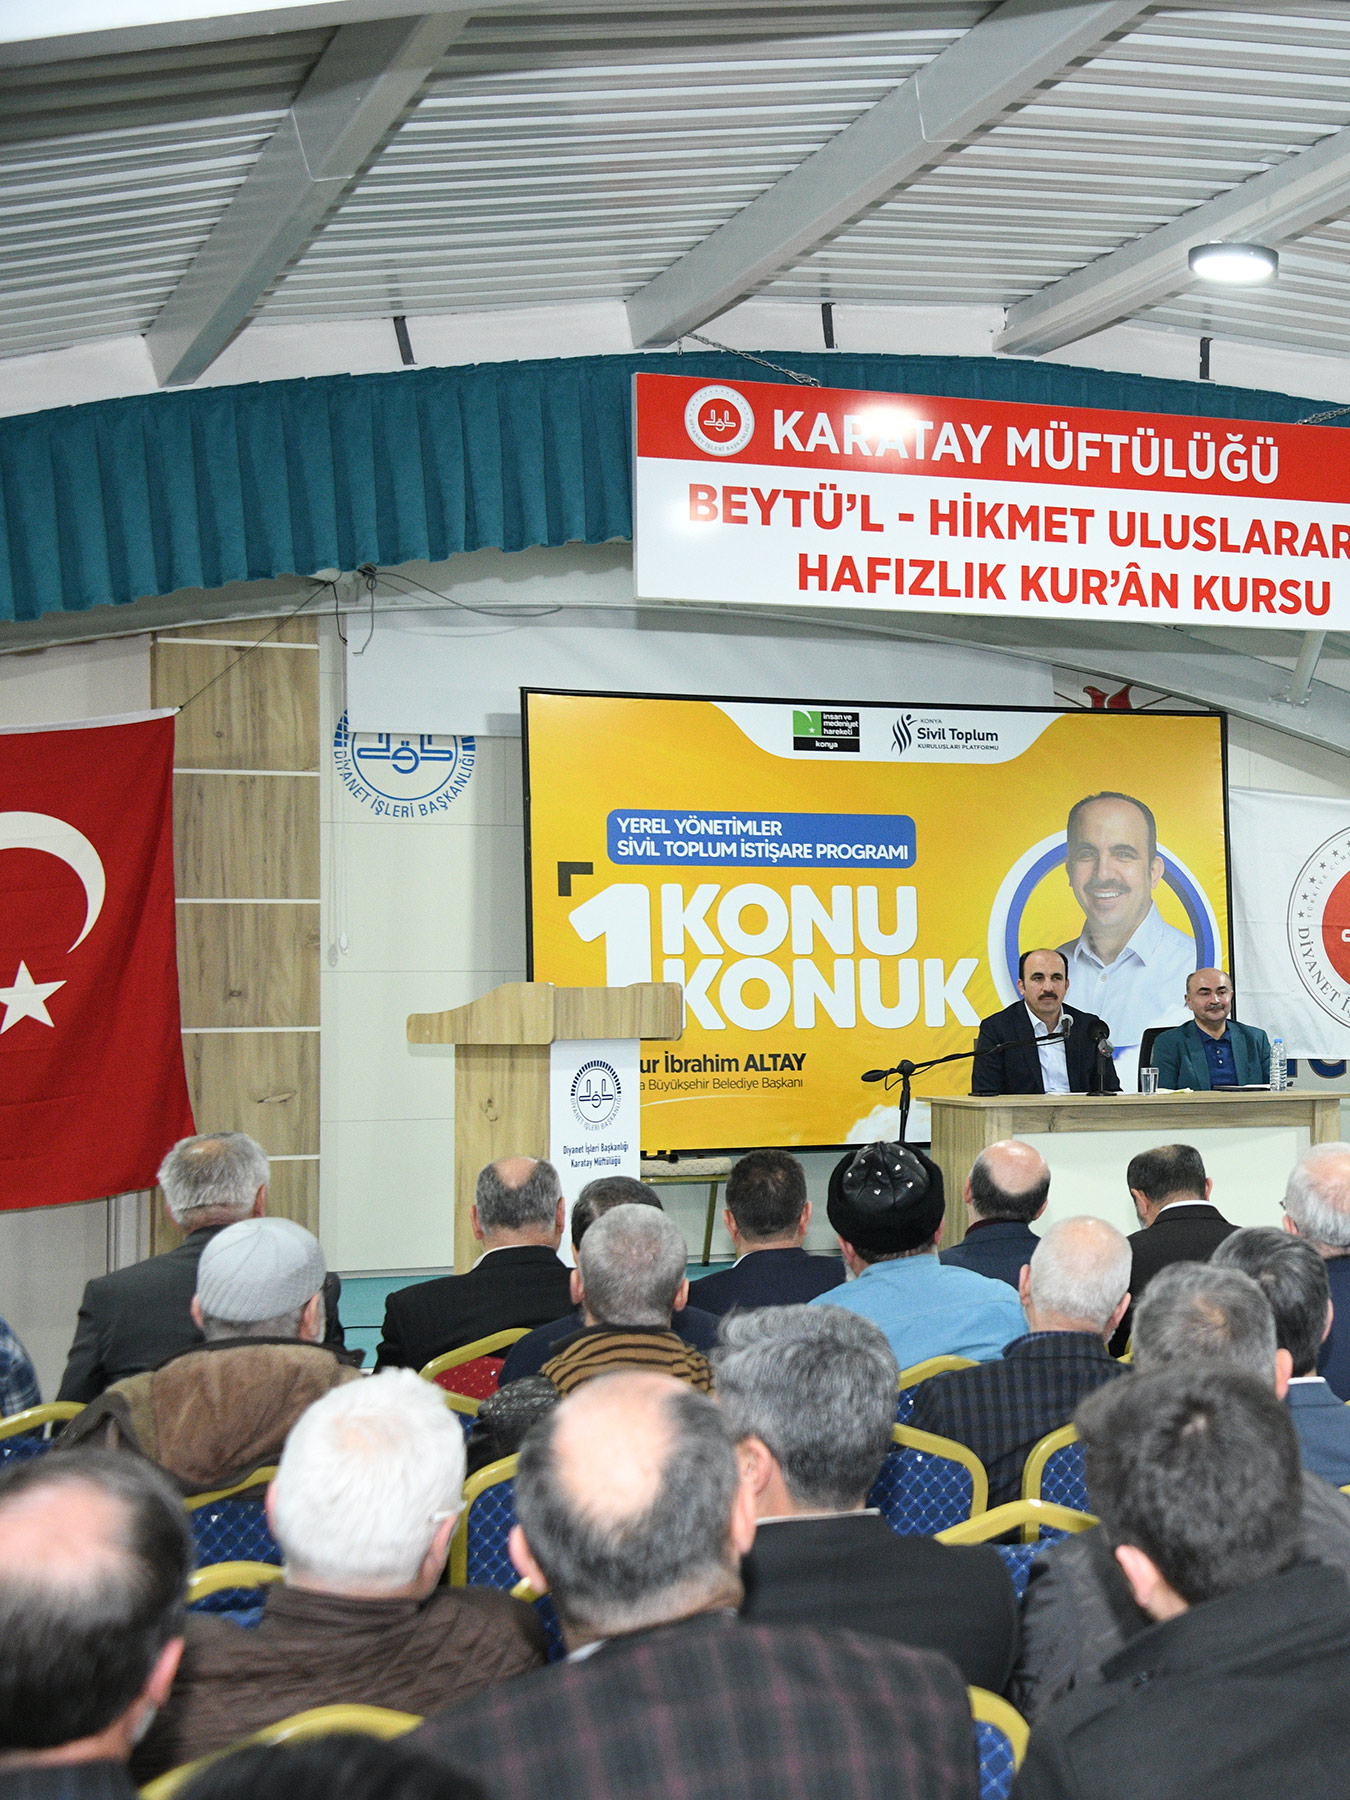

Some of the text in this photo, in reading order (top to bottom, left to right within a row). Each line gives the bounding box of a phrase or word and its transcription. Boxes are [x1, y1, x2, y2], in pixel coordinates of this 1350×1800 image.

[773, 408, 1279, 484] KARATAY MÜFTÜLÜĞÜ
[929, 492, 1095, 544] HİKMET
[798, 552, 1007, 600] HAFIZLIK
[1193, 574, 1331, 616] KURSU
[823, 720, 859, 729] medeniyet
[823, 727, 853, 736] hareketi
[917, 727, 999, 744] Sivil Toplum
[815, 740, 839, 750] konya
[370, 795, 415, 818] İŞLERİ
[418, 753, 476, 817] BAŞKANLIĞI
[616, 815, 783, 836] YEREL YÖNETİMLER
[617, 838, 909, 863] SİVİL TOPLUM İSTİŞARE PROGRAMI
[568, 883, 918, 987] 1 KONU
[1298, 926, 1341, 1004] DİYANET
[662, 958, 980, 1031] KONUK
[664, 1051, 740, 1074] İbrahim
[743, 1053, 807, 1072] ALTAY
[648, 1079, 709, 1093] Büyükşehir
[712, 1077, 759, 1091] Belediye
[761, 1076, 804, 1090] Başkanı
[563, 1141, 629, 1156] Diyanet İşleri Başkanlığı
[571, 1159, 592, 1169] Karatay
